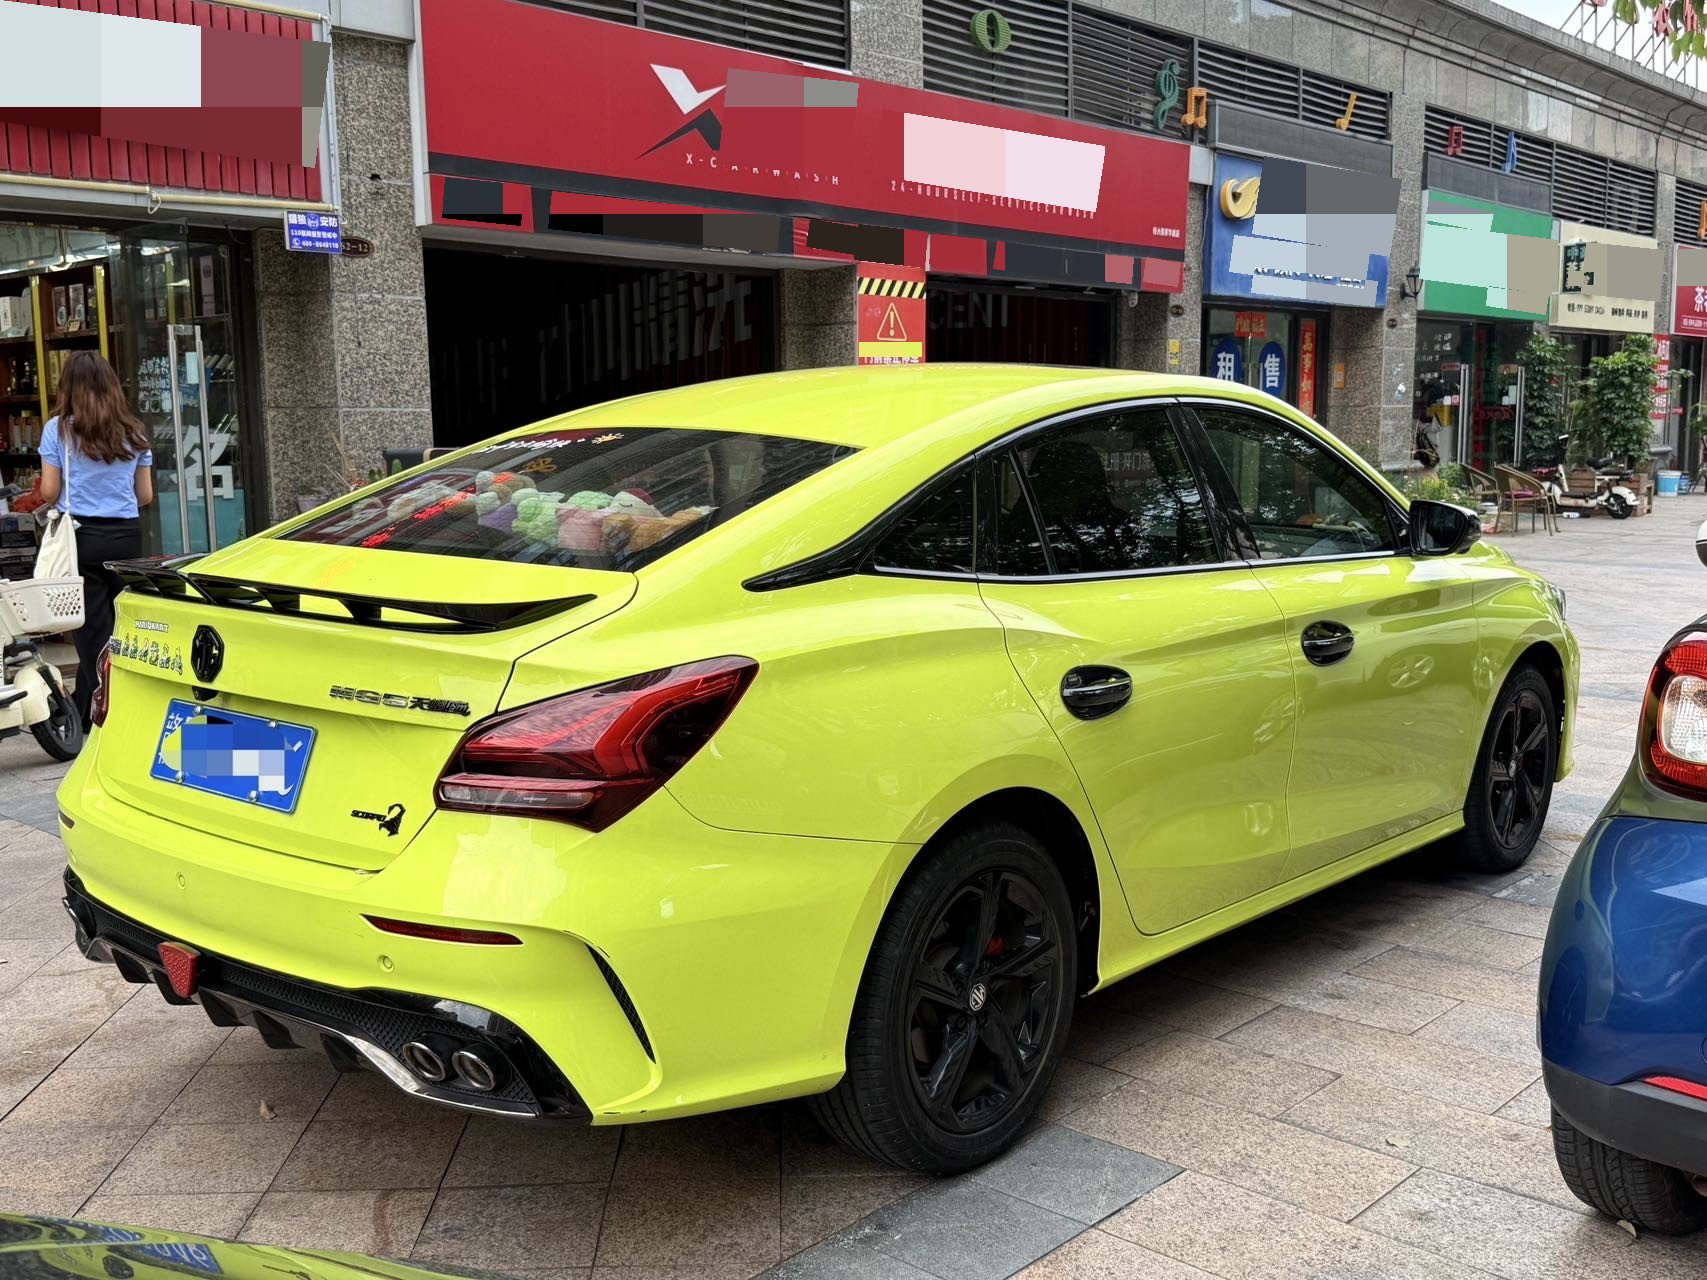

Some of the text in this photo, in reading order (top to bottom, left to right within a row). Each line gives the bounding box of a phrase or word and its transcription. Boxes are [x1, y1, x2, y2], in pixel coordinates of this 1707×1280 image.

[319, 216, 338, 228] 安防
[1217, 351, 1235, 382] 租
[1263, 353, 1280, 388] 售
